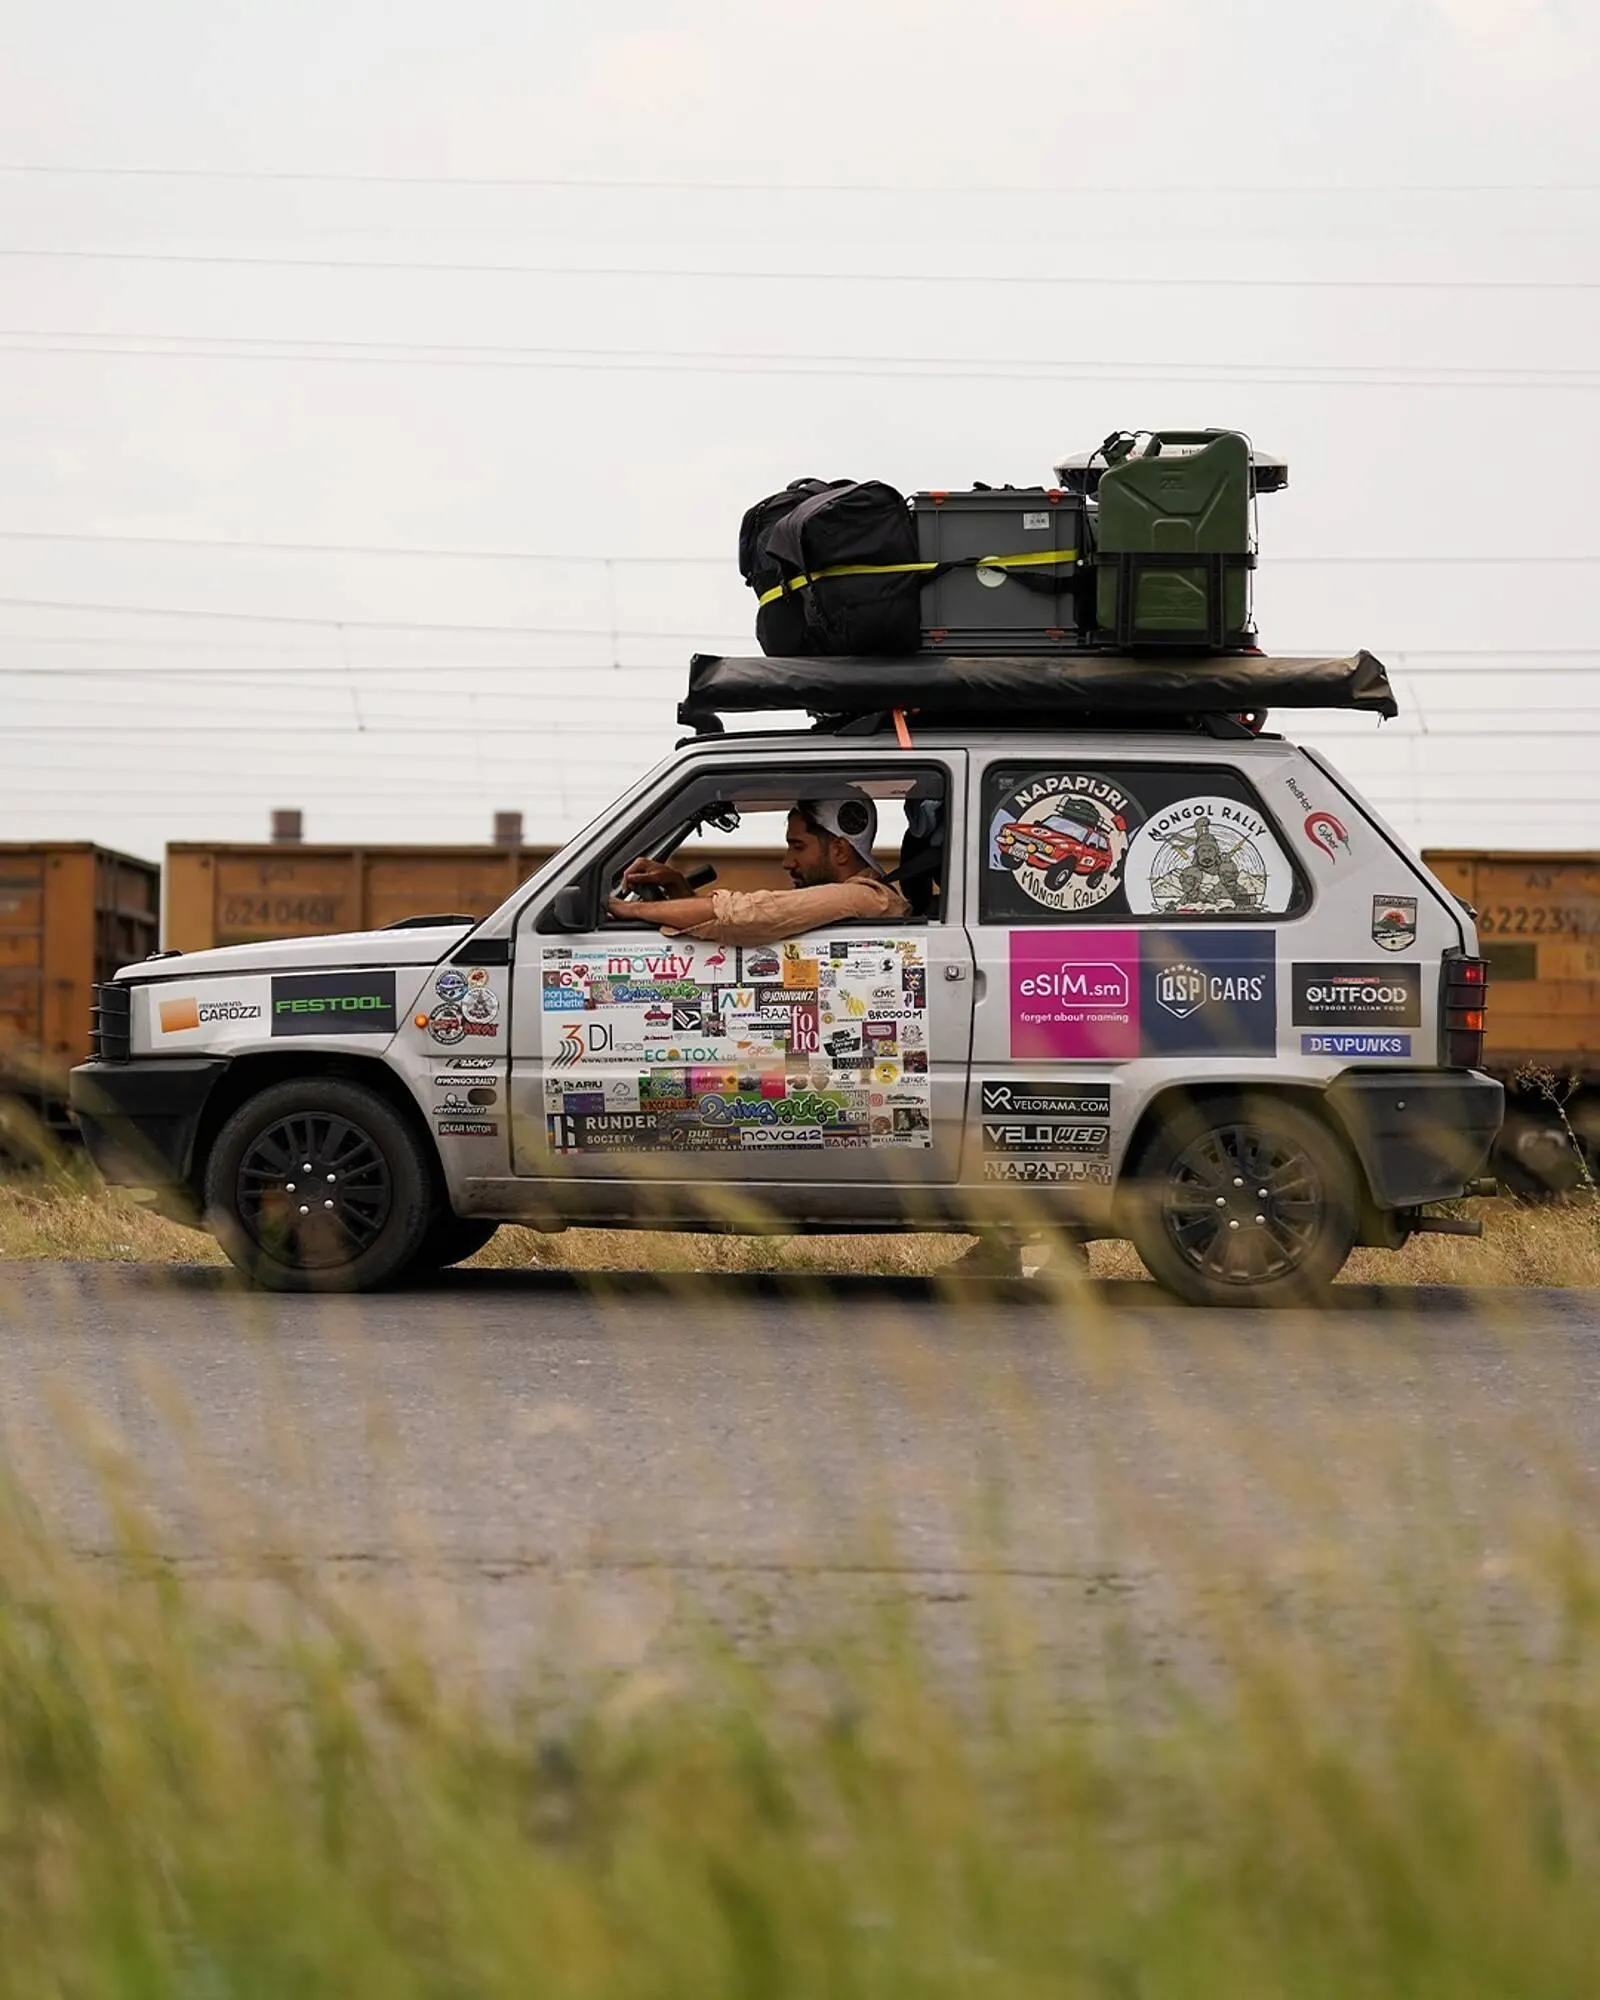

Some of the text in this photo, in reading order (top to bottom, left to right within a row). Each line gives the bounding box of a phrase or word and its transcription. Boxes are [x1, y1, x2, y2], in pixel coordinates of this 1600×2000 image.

[1014, 774, 1129, 811] NAPAPIJRI
[1285, 778, 1313, 813] RedHot
[1148, 805, 1268, 841] MONGOL RALLY
[1317, 823, 1340, 851] Cyber
[1021, 872, 1110, 909] MONGOL RALLY
[608, 954, 694, 978] movity
[1020, 974, 1121, 997] eSIM.sm
[1162, 976, 1262, 1001] QSP CARS
[1306, 986, 1408, 1004] OUTFOOD
[200, 1006, 261, 1022] CAROZZI
[275, 996, 392, 1014] FESTOOL
[1020, 1012, 1128, 1022] forget about roaming
[1310, 1038, 1401, 1052] DEVPUNKS
[1013, 1100, 1109, 1112] VELORAMA.COM
[586, 1115, 657, 1130] RUNDER
[586, 1134, 635, 1144] SOCIETY
[741, 1129, 822, 1141] nova42
[985, 1125, 1108, 1145] VELO WEB
